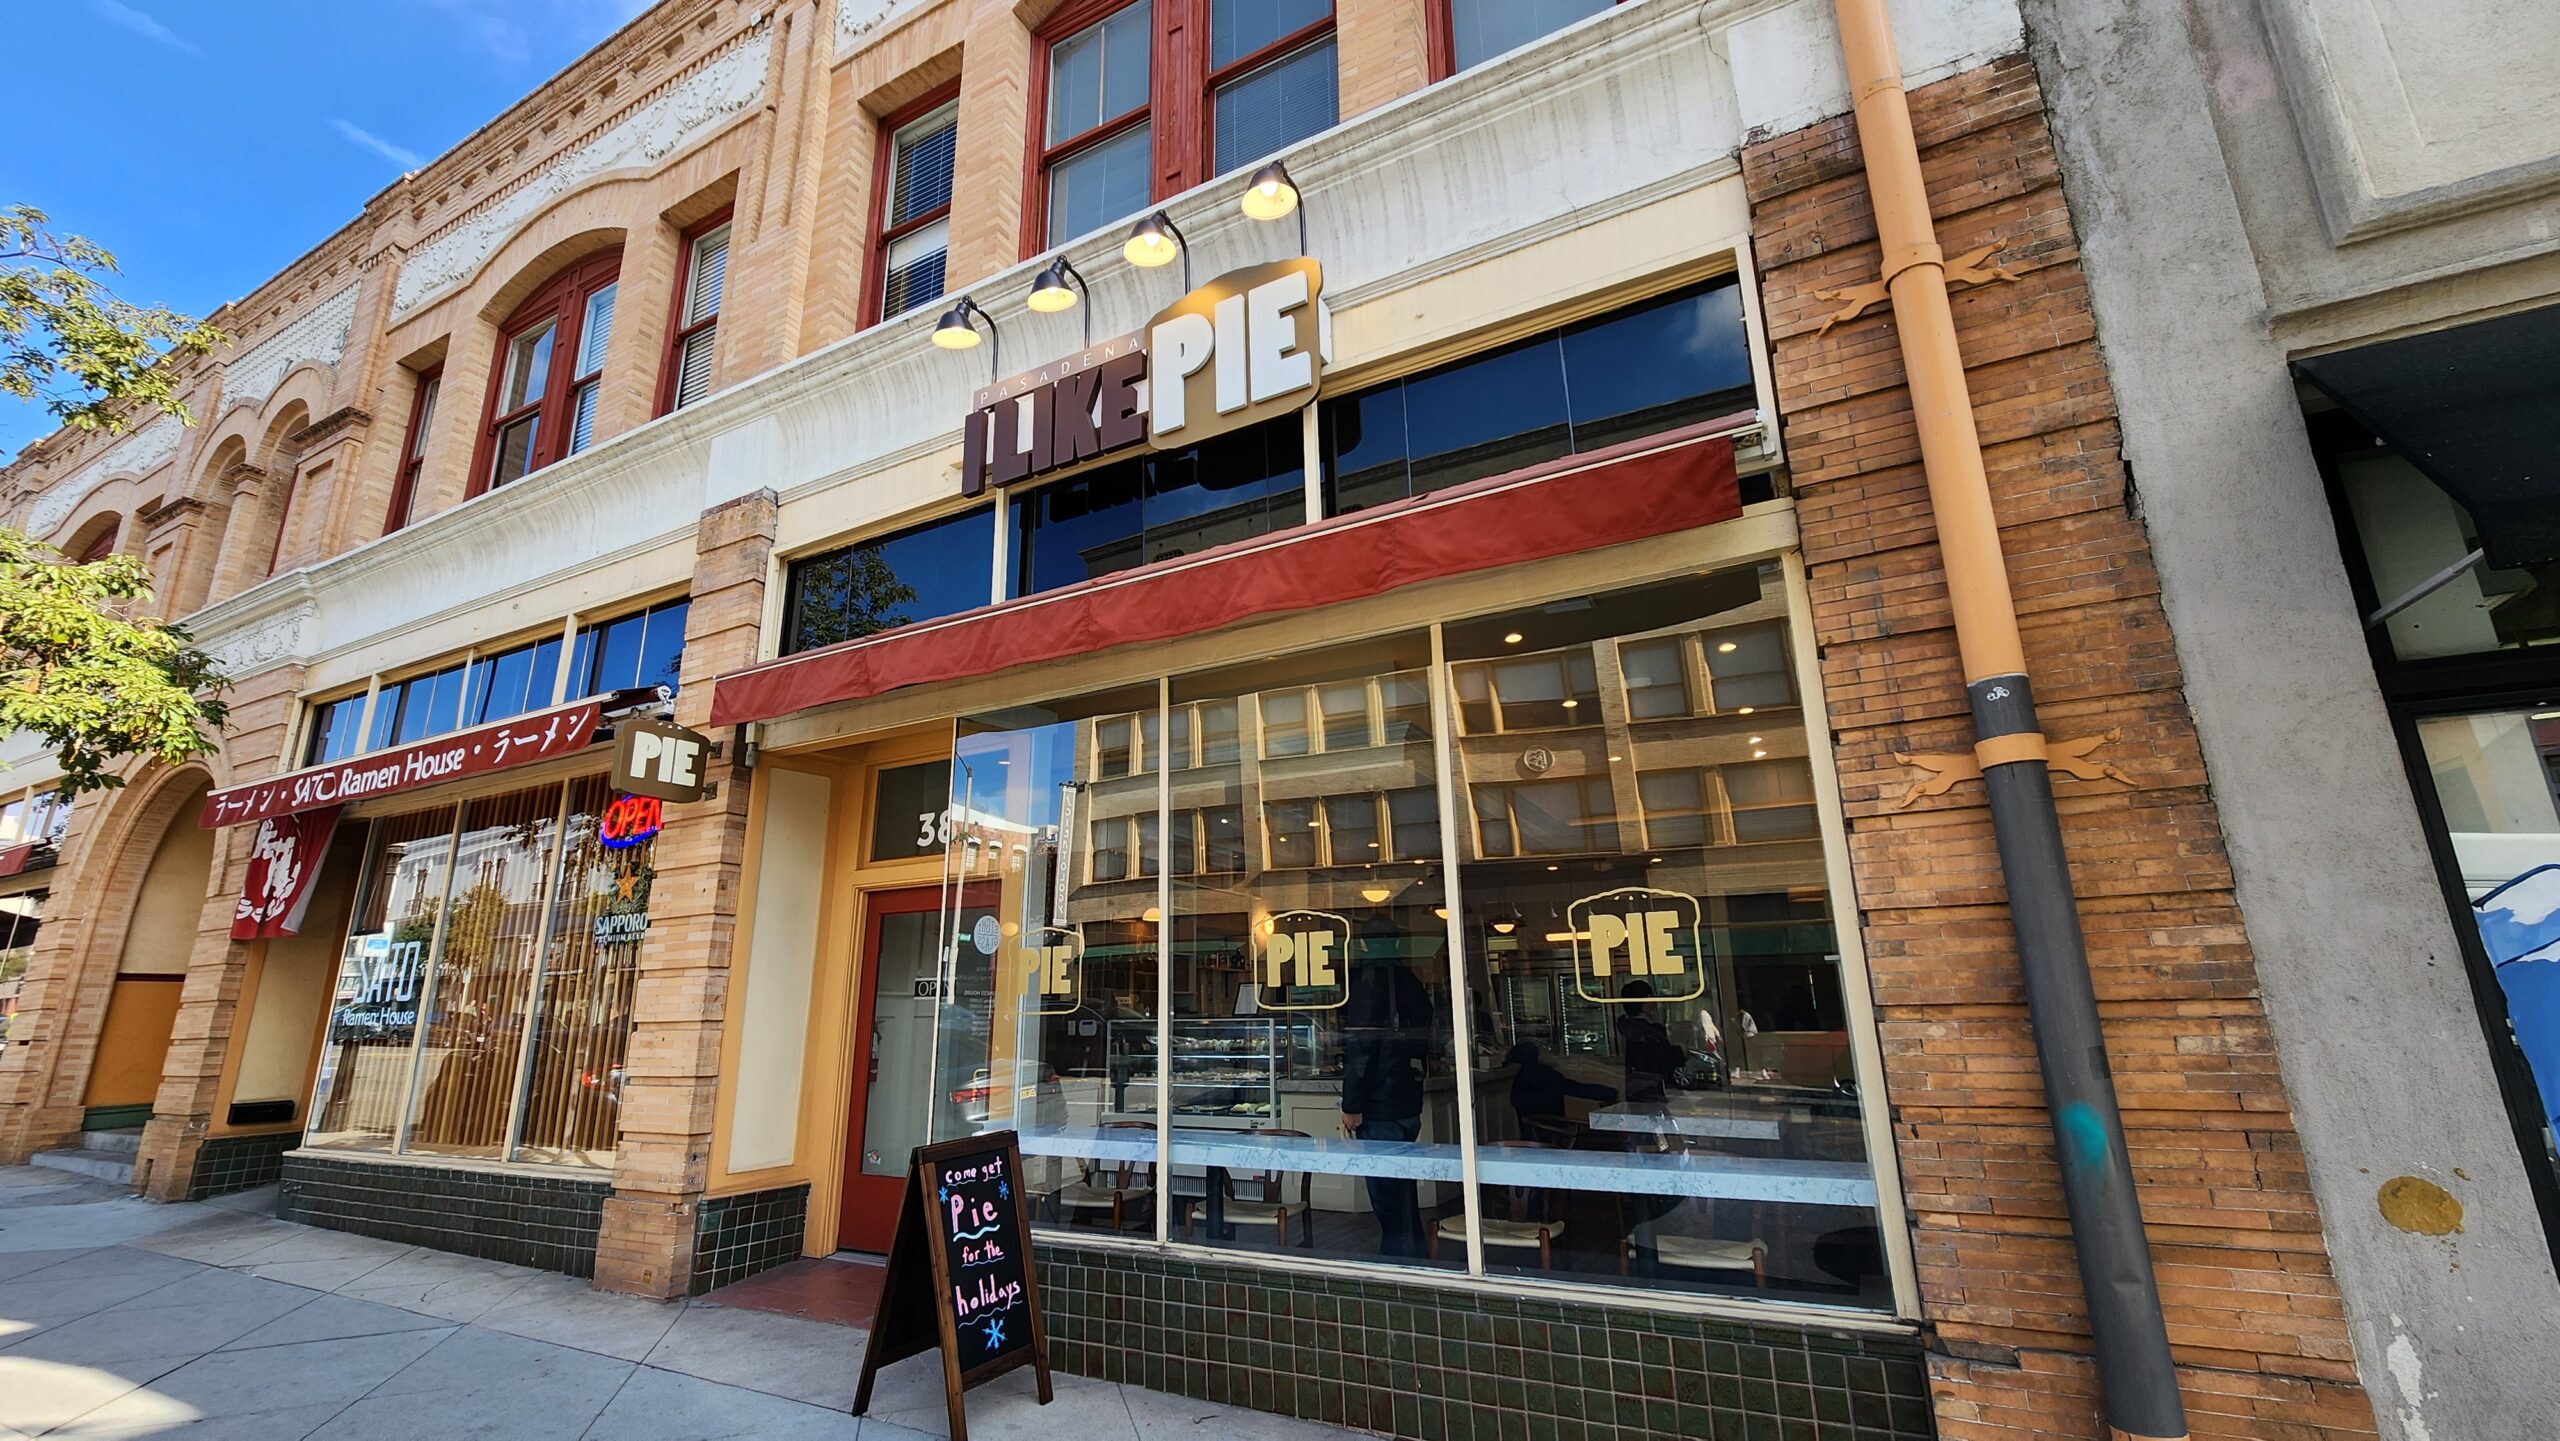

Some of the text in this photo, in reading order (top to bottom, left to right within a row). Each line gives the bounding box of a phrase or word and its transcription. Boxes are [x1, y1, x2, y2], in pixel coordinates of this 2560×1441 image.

[962, 270, 1313, 498] I LIKE PIE
[980, 336, 1139, 405] PASADENA
[493, 706, 592, 764] ラーメン
[291, 746, 466, 807] SATO Ramen House
[630, 730, 700, 787] PIE
[215, 786, 276, 822] ラーメン
[603, 797, 663, 840] OPEN
[916, 809, 957, 847] 38
[594, 932, 645, 944] PREMIUM BEER
[595, 912, 648, 935] SAPPORO
[1589, 910, 1685, 977] PIE
[353, 941, 421, 1003] SATO
[1018, 945, 1072, 995] PIE
[1267, 930, 1336, 988] PIE
[918, 981, 950, 997] OPN
[342, 1007, 415, 1027] Ramen House
[982, 1156, 1002, 1182] get
[950, 1194, 998, 1233] Pie
[962, 1245, 980, 1264] for
[955, 1273, 1021, 1316] holidays
